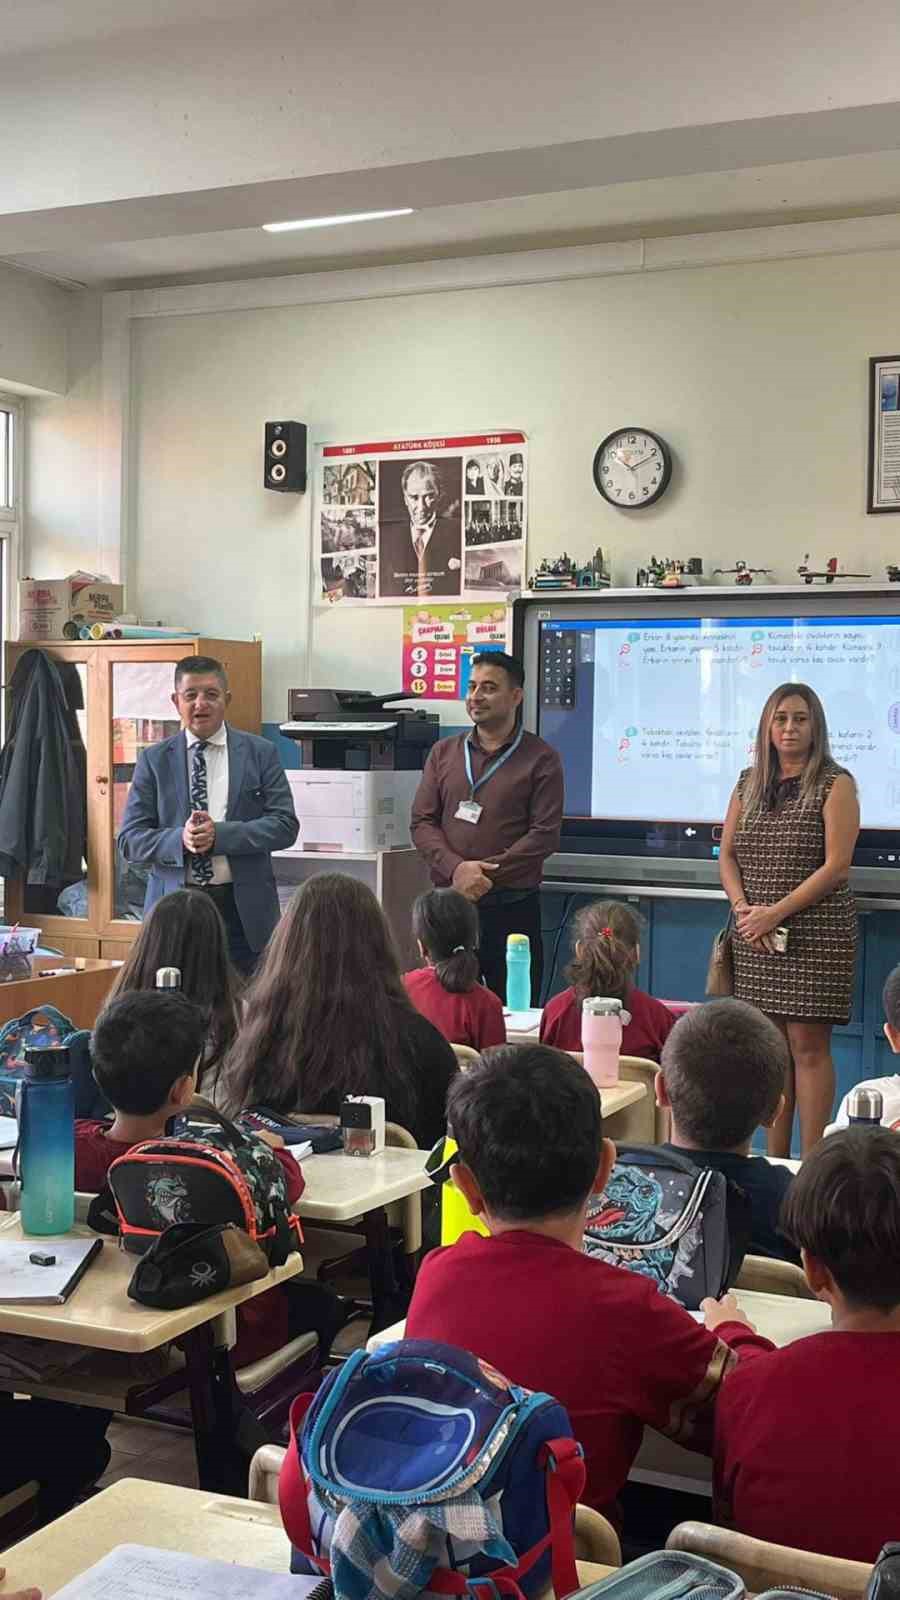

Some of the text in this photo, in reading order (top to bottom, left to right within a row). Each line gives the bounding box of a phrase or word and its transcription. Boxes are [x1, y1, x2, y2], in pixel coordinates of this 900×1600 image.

[627, 435, 637, 444] 12
[393, 441, 423, 451] ATATÜRK
[650, 448, 657, 457] 2
[602, 466, 609, 474] 9
[655, 462, 662, 471] 3
[606, 479, 614, 488] 8
[650, 476, 657, 485] 4
[615, 488, 623, 497] 7
[628, 491, 636, 500] 6
[642, 486, 649, 496] 5
[418, 625, 444, 636] ÇARPMA
[416, 649, 423, 659] 5
